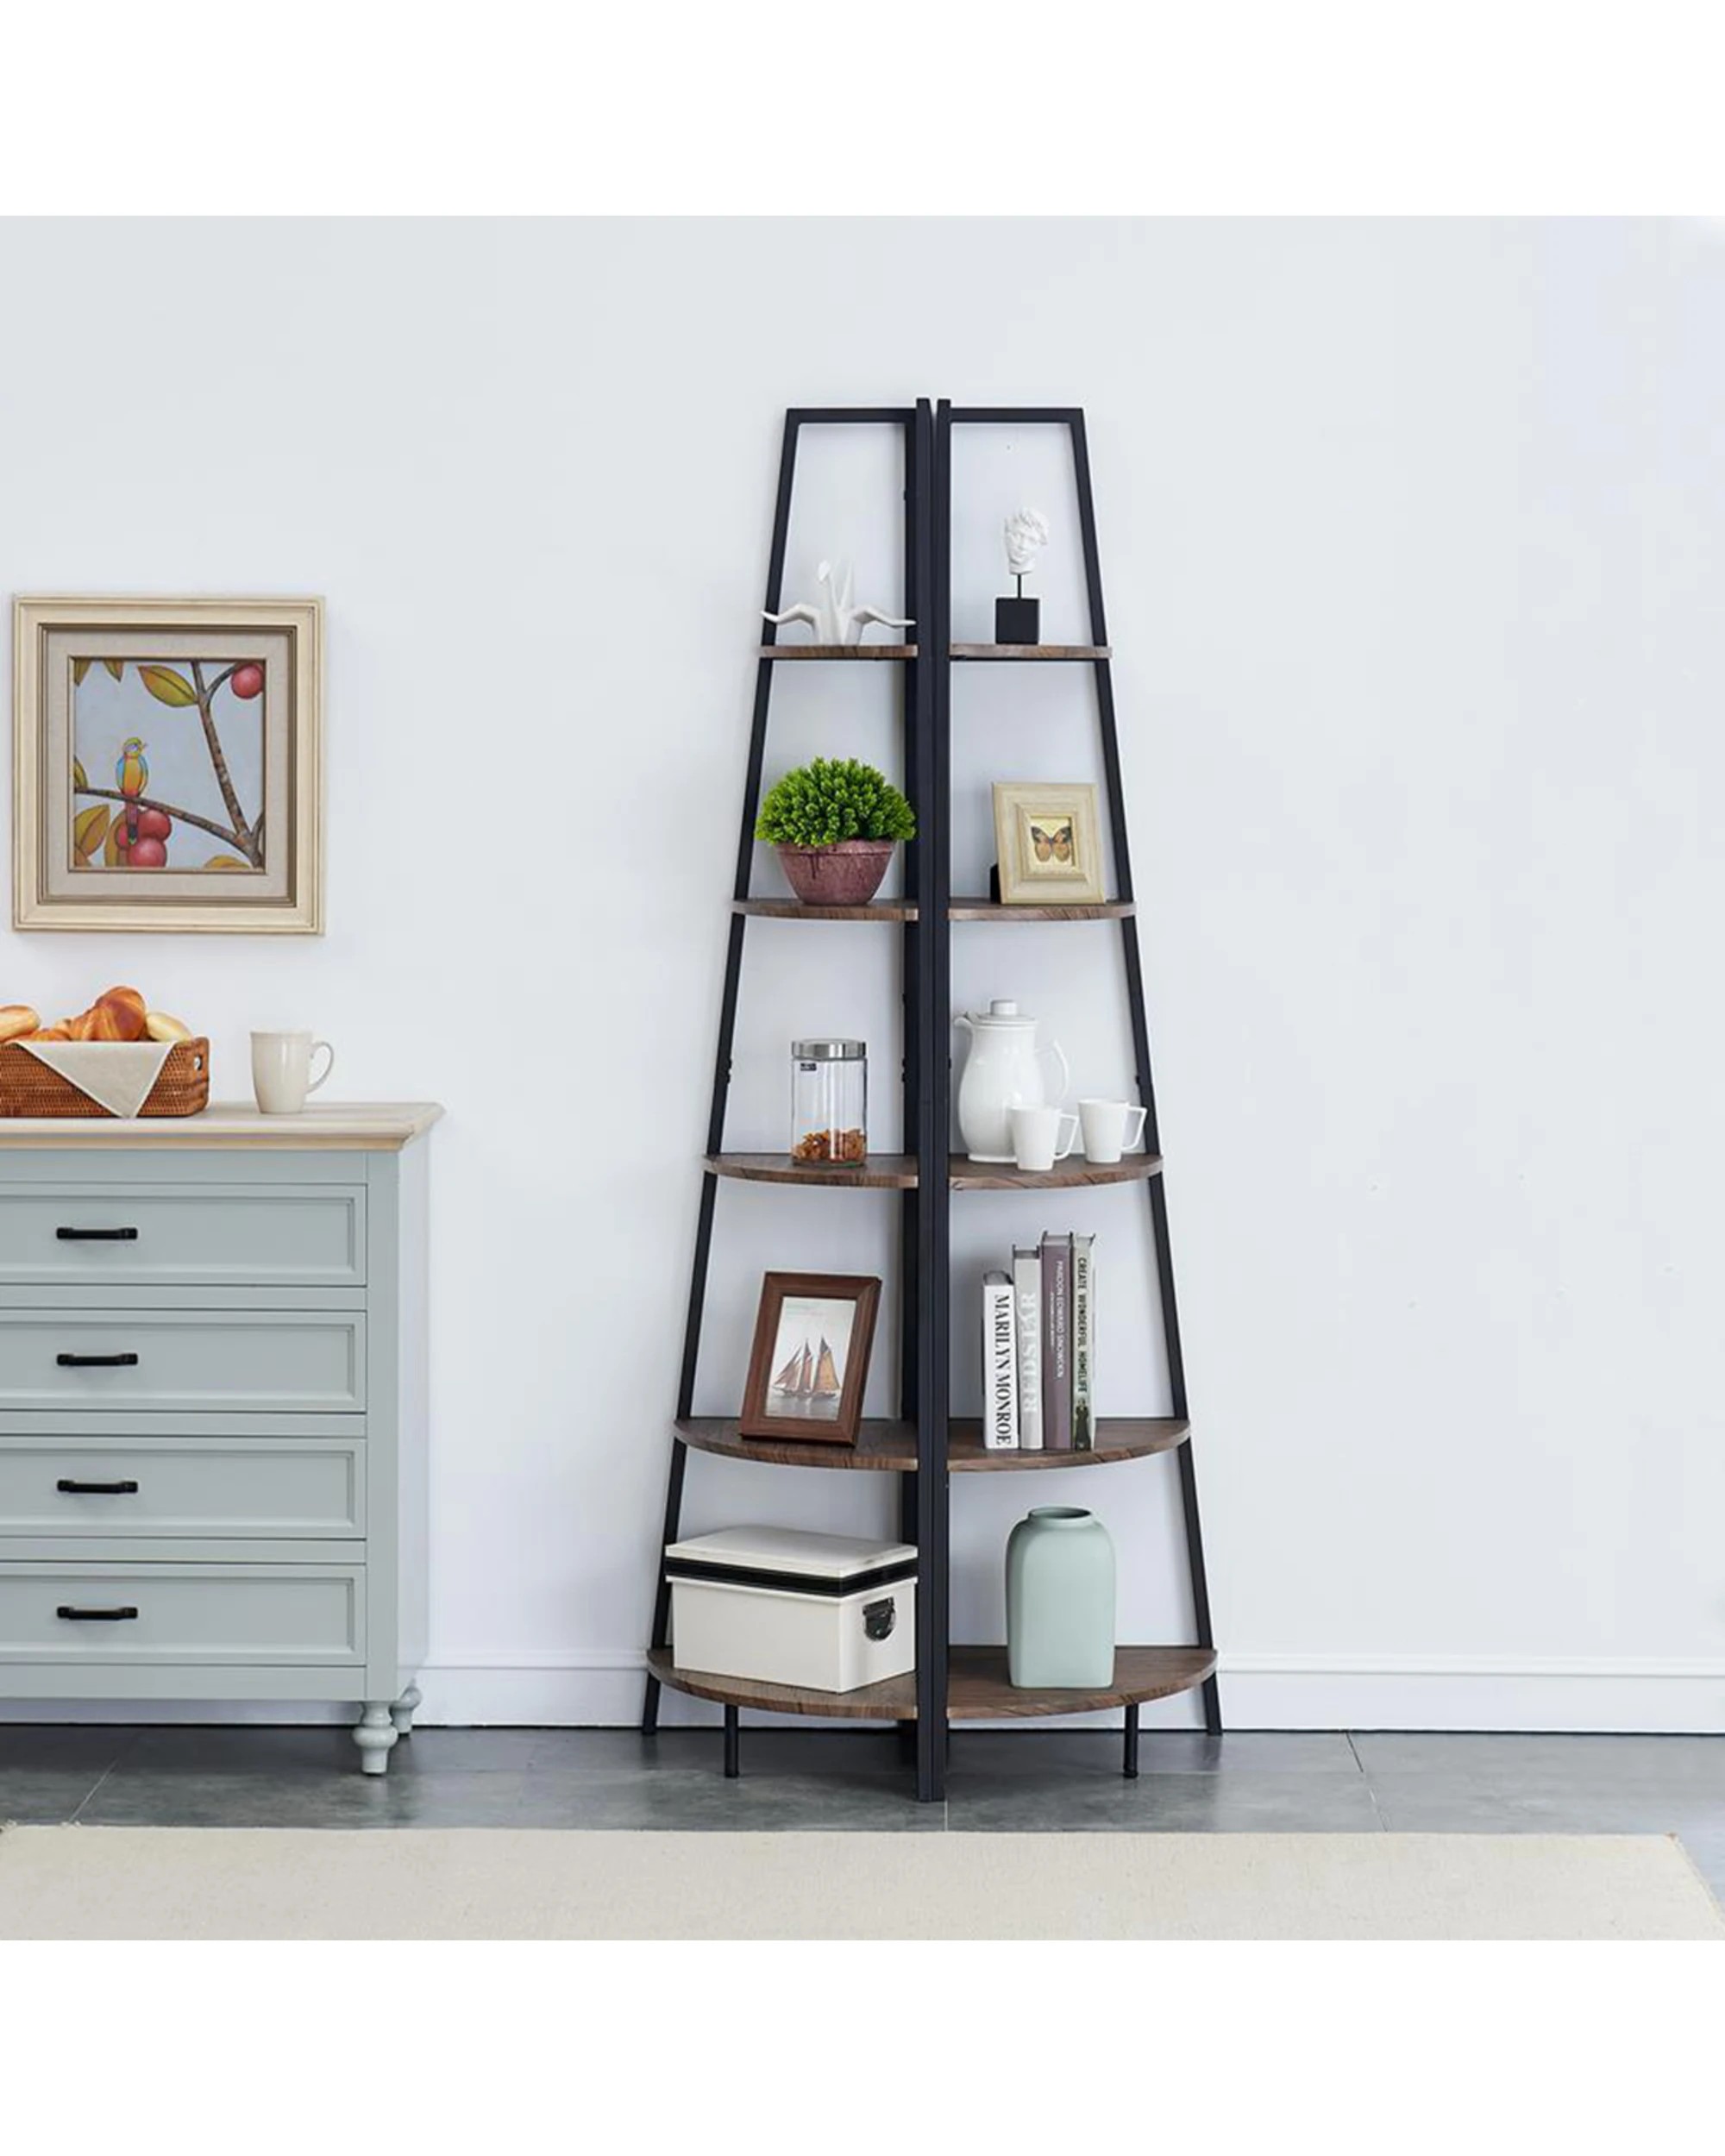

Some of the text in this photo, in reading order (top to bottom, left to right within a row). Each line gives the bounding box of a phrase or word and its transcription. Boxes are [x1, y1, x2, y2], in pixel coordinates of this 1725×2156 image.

[994, 1294, 1013, 1445] MARILYN MONROE
[1077, 1257, 1088, 1393] CREATE WONDERFUL HOMELIFE
